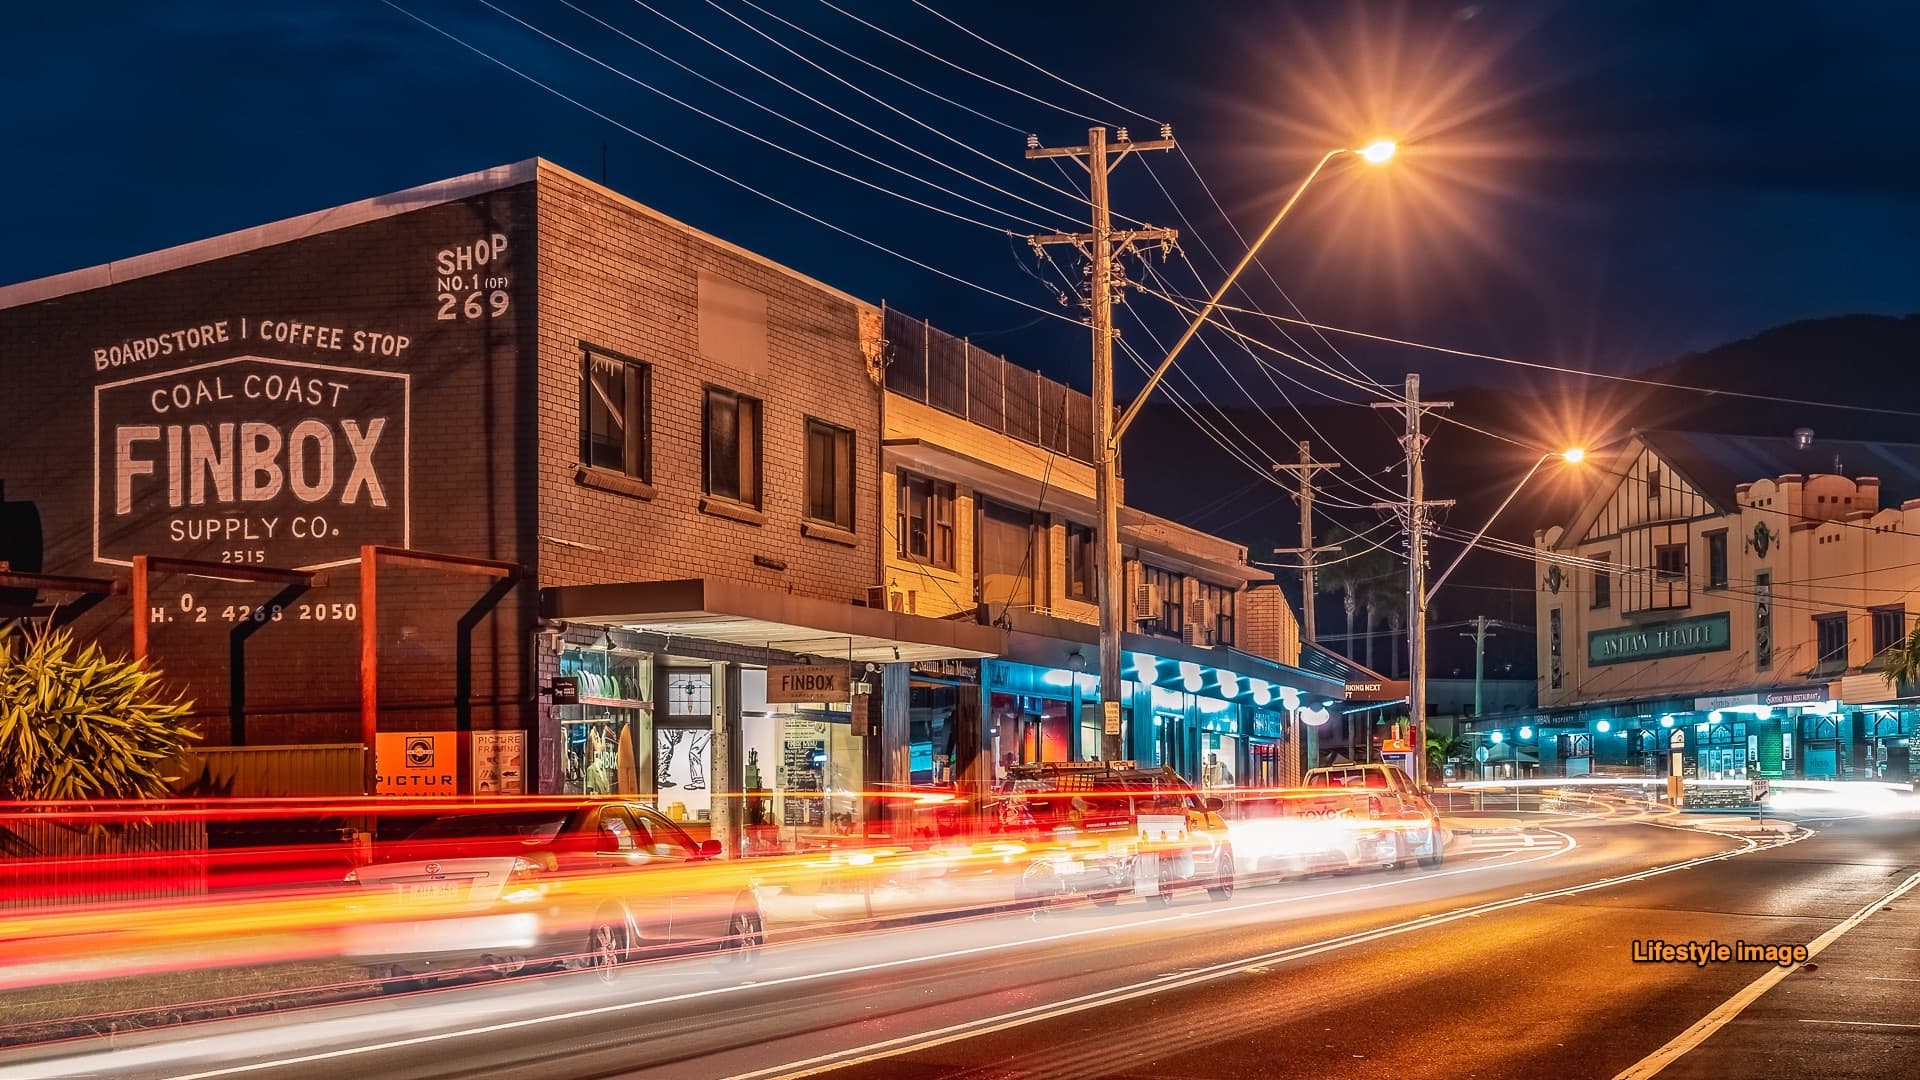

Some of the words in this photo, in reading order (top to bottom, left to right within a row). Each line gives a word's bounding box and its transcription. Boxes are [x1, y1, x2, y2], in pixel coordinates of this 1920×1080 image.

[438, 233, 508, 275] SHOP
[485, 277, 508, 289] (OF)
[437, 290, 510, 320] 269
[94, 321, 229, 371] BOARDSTORE
[260, 320, 344, 350] COFFEE
[352, 331, 410, 357] STOP
[152, 377, 234, 413] COAL
[244, 374, 349, 407] COAST
[116, 418, 388, 515] FINBOX
[170, 517, 279, 541] SUPPLY
[292, 516, 340, 539] CO.
[222, 550, 265, 564] 2515
[151, 607, 174, 623] H.
[221, 605, 283, 622] 4268
[299, 603, 357, 621] 2050
[781, 674, 835, 691] FINBOX
[478, 736, 520, 744] PICTURE
[478, 745, 520, 753] FRAMING
[376, 775, 452, 785] PICTUR
